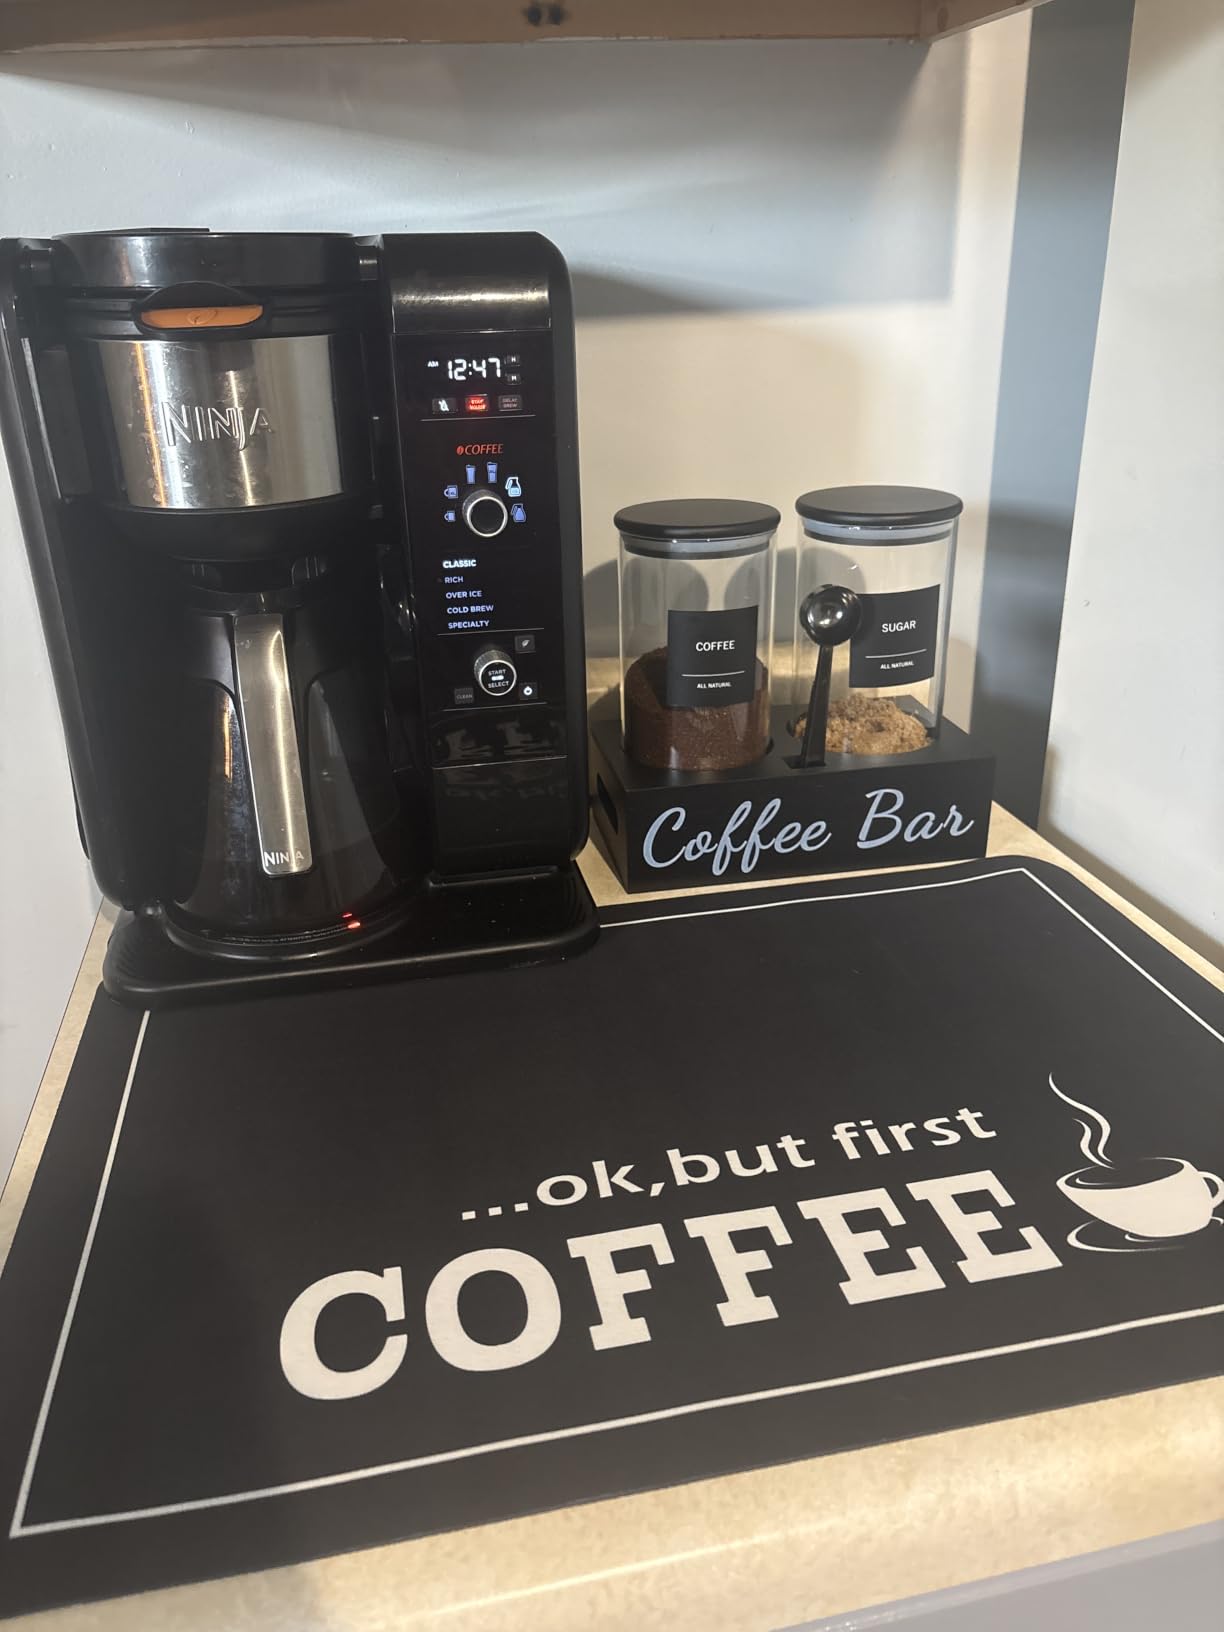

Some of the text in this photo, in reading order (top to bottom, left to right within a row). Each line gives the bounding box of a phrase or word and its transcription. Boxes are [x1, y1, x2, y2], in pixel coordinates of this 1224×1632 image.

[447, 357, 502, 381] 12:47
[159, 401, 274, 451] NINJA
[464, 443, 504, 456] COFFEE
[442, 559, 477, 569] CLASSIC
[444, 575, 464, 584] RICH
[445, 590, 483, 599] OVER ICE
[446, 604, 494, 614] COLD BREW
[447, 619, 490, 630] SPECIALTY
[881, 619, 917, 633] SUGAR
[695, 639, 736, 652] COFFEE
[880, 660, 915, 670] ALL NATURAL
[487, 668, 507, 677] START
[487, 680, 510, 689] SELECT
[696, 681, 732, 690] ALL NATURAL
[642, 788, 975, 876] Coffee Bar
[263, 850, 305, 868] NINA
[831, 1106, 998, 1160] first
[279, 1168, 1063, 1401] COFFEE
